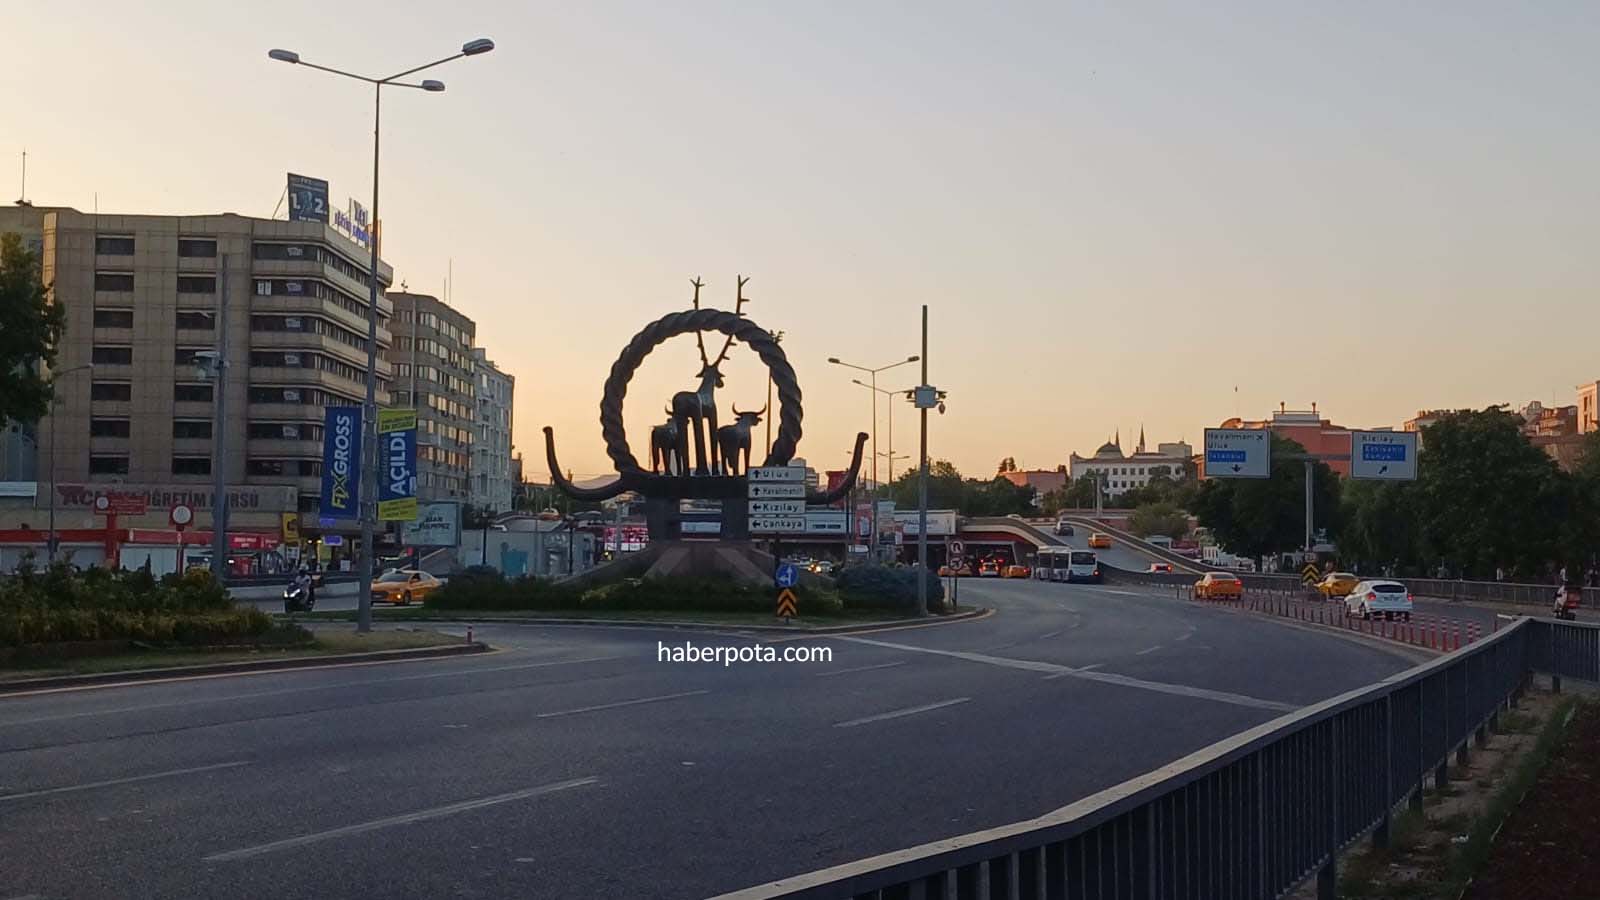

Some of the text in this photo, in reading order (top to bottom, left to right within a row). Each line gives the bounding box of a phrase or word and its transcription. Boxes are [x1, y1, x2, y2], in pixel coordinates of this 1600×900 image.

[389, 431, 410, 496] AÇILDI
[762, 503, 799, 513] Kızılay
[762, 519, 803, 530] Çankaya
